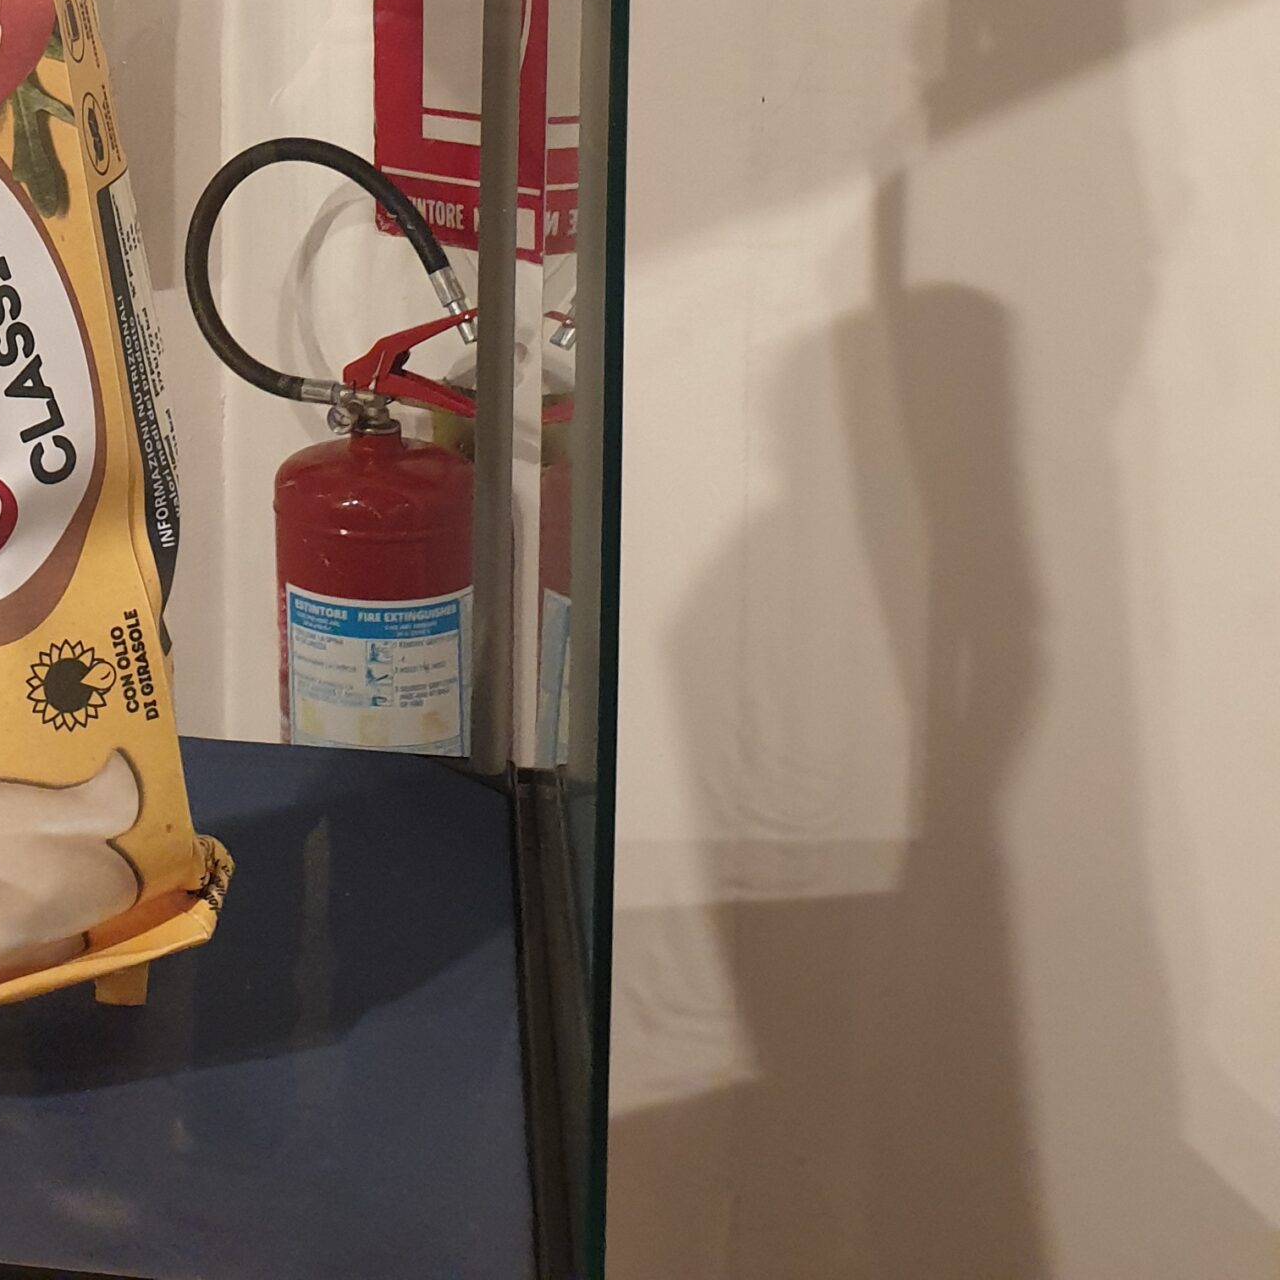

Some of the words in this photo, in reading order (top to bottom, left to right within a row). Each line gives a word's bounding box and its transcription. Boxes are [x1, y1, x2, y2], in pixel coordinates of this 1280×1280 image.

[117, 295, 146, 418] NUTRIZIONALI
[142, 395, 155, 421] del
[151, 423, 168, 466] medi
[140, 421, 176, 548] INFORMAZIONI
[357, 611, 383, 623] FIRE
[110, 626, 131, 671] OLIO
[123, 608, 155, 697] GIRASOLE
[120, 673, 139, 714] CON
[143, 699, 160, 721] DI
